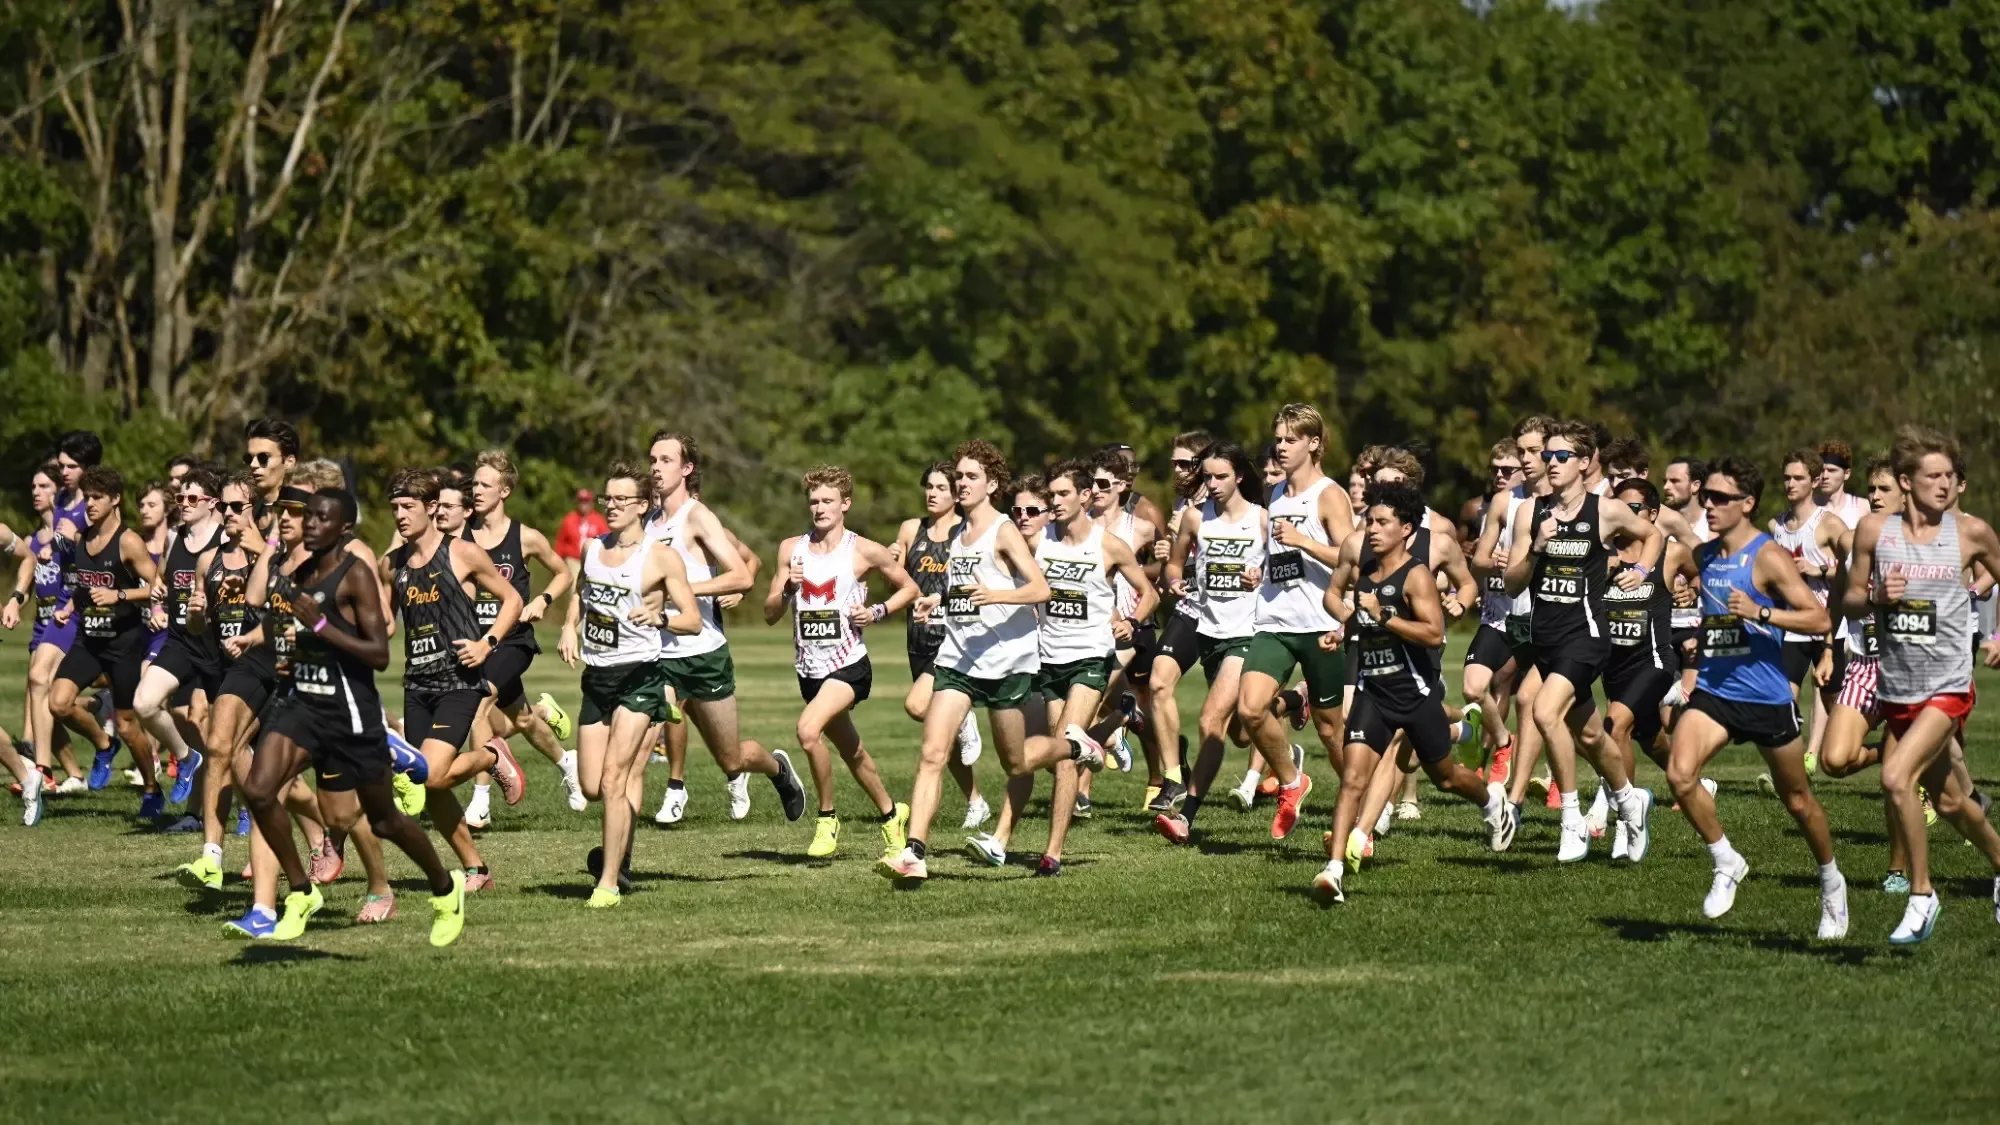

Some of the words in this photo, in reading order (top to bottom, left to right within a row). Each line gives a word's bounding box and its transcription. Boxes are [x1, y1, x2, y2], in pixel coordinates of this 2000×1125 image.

[1205, 538, 1254, 558] S&T
[1044, 558, 1097, 581] S&T
[1272, 563, 1299, 579] 2255
[1880, 562, 1955, 580] WLDCATS
[173, 570, 195, 589] SE
[1209, 575, 1241, 588] 2254
[1490, 577, 1505, 589] 22
[1541, 578, 1576, 594] 2176
[1708, 578, 1731, 588] ITALIA
[407, 584, 439, 606] Park
[589, 581, 630, 606] S&T
[800, 575, 838, 605] M
[476, 603, 497, 615] 443
[1050, 601, 1083, 616] 2253
[85, 616, 112, 629] 2444
[220, 622, 242, 636] 237
[803, 622, 836, 637] 2204
[1609, 621, 1642, 636] 2173
[1888, 613, 1930, 632] 2094
[587, 623, 614, 643] 2249
[1707, 629, 1740, 646] 2567
[411, 636, 437, 654] 2371
[1363, 648, 1395, 665] 2175
[295, 663, 328, 682] 2174
